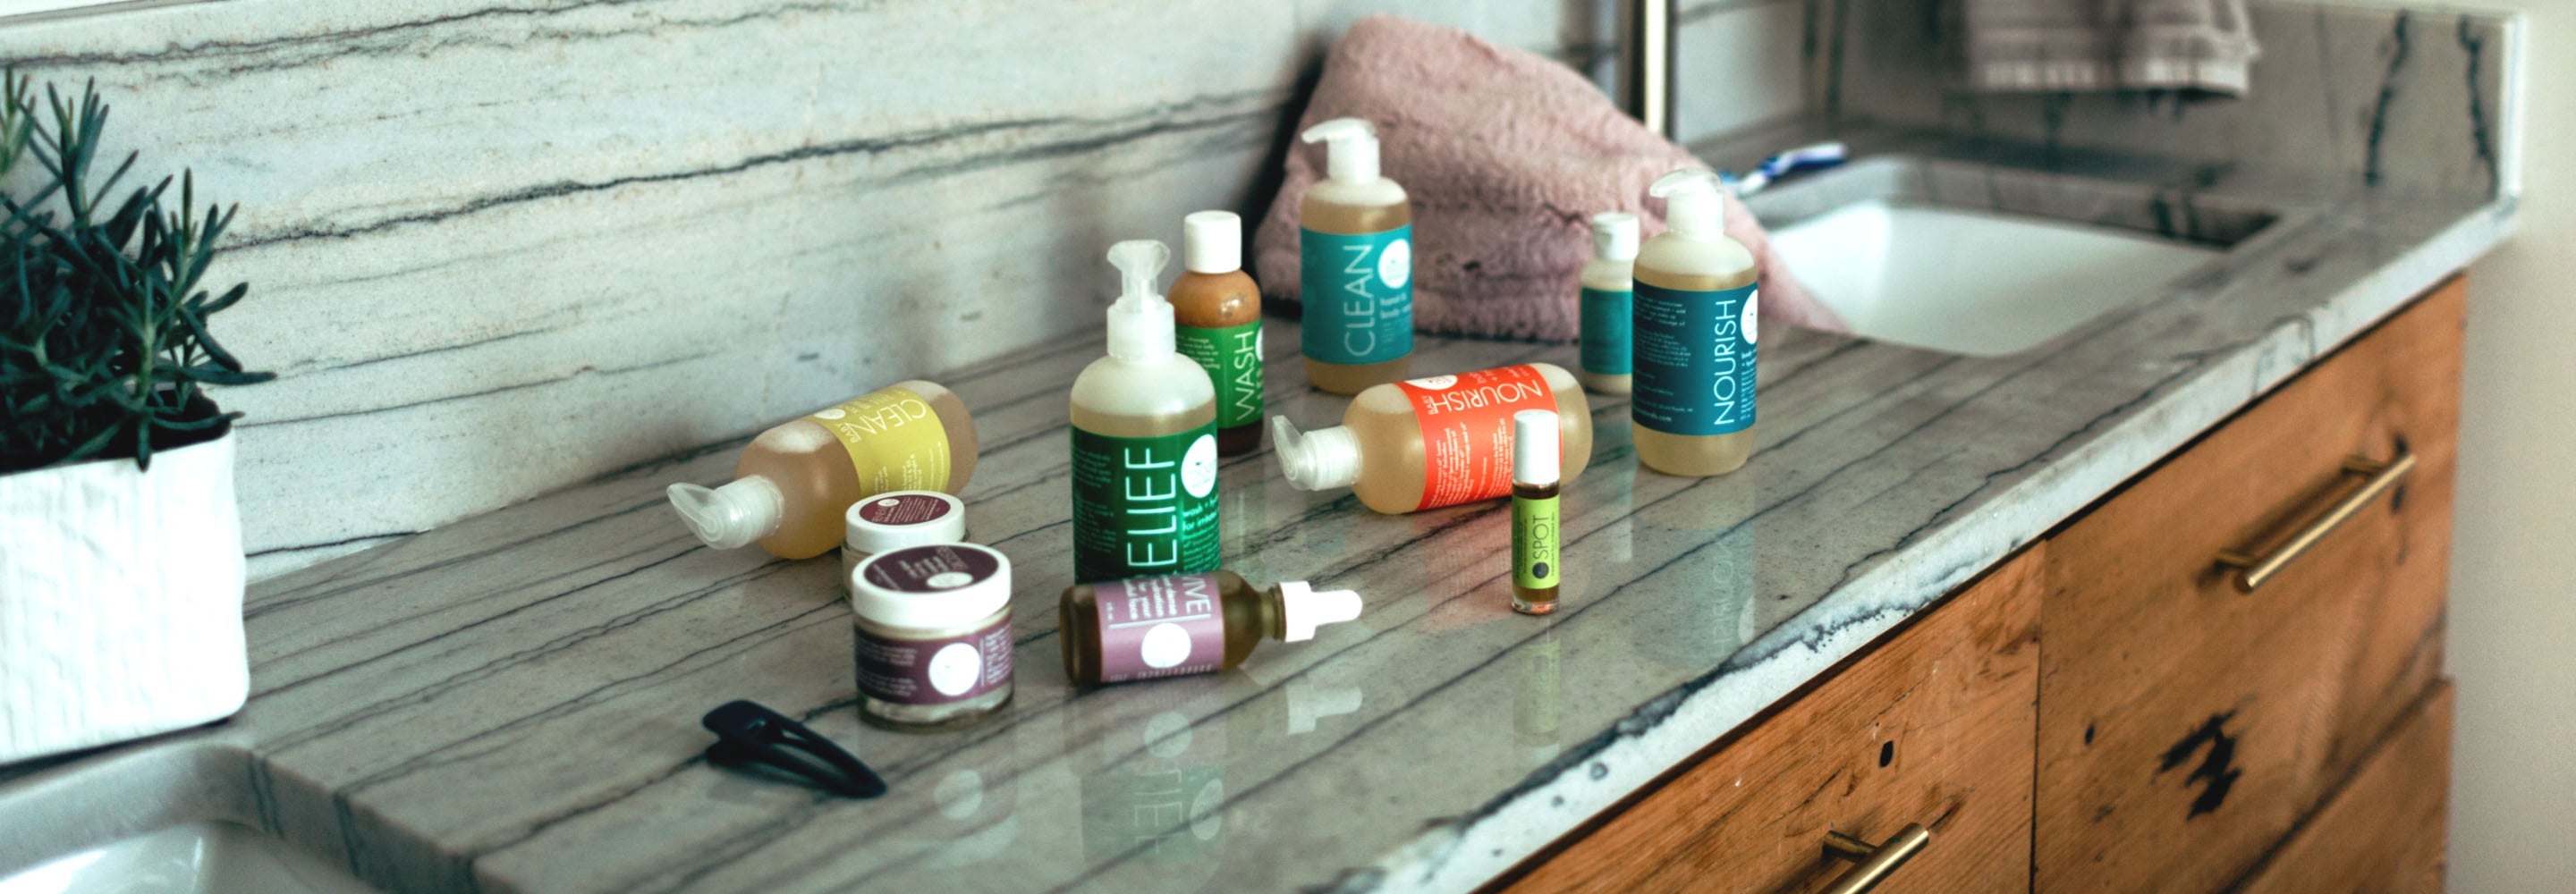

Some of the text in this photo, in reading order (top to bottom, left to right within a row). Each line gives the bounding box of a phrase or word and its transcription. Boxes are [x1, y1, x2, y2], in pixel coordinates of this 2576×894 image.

[1343, 243, 1376, 357] CLEAN
[1233, 330, 1256, 421] WASH
[1428, 378, 1543, 413] NOURISH
[1713, 299, 1737, 426] NOURISH
[835, 422, 860, 443] BABY
[843, 399, 927, 442] CLEAN
[1124, 448, 1178, 569] ELIEF
[1532, 514, 1549, 560] SPOT
